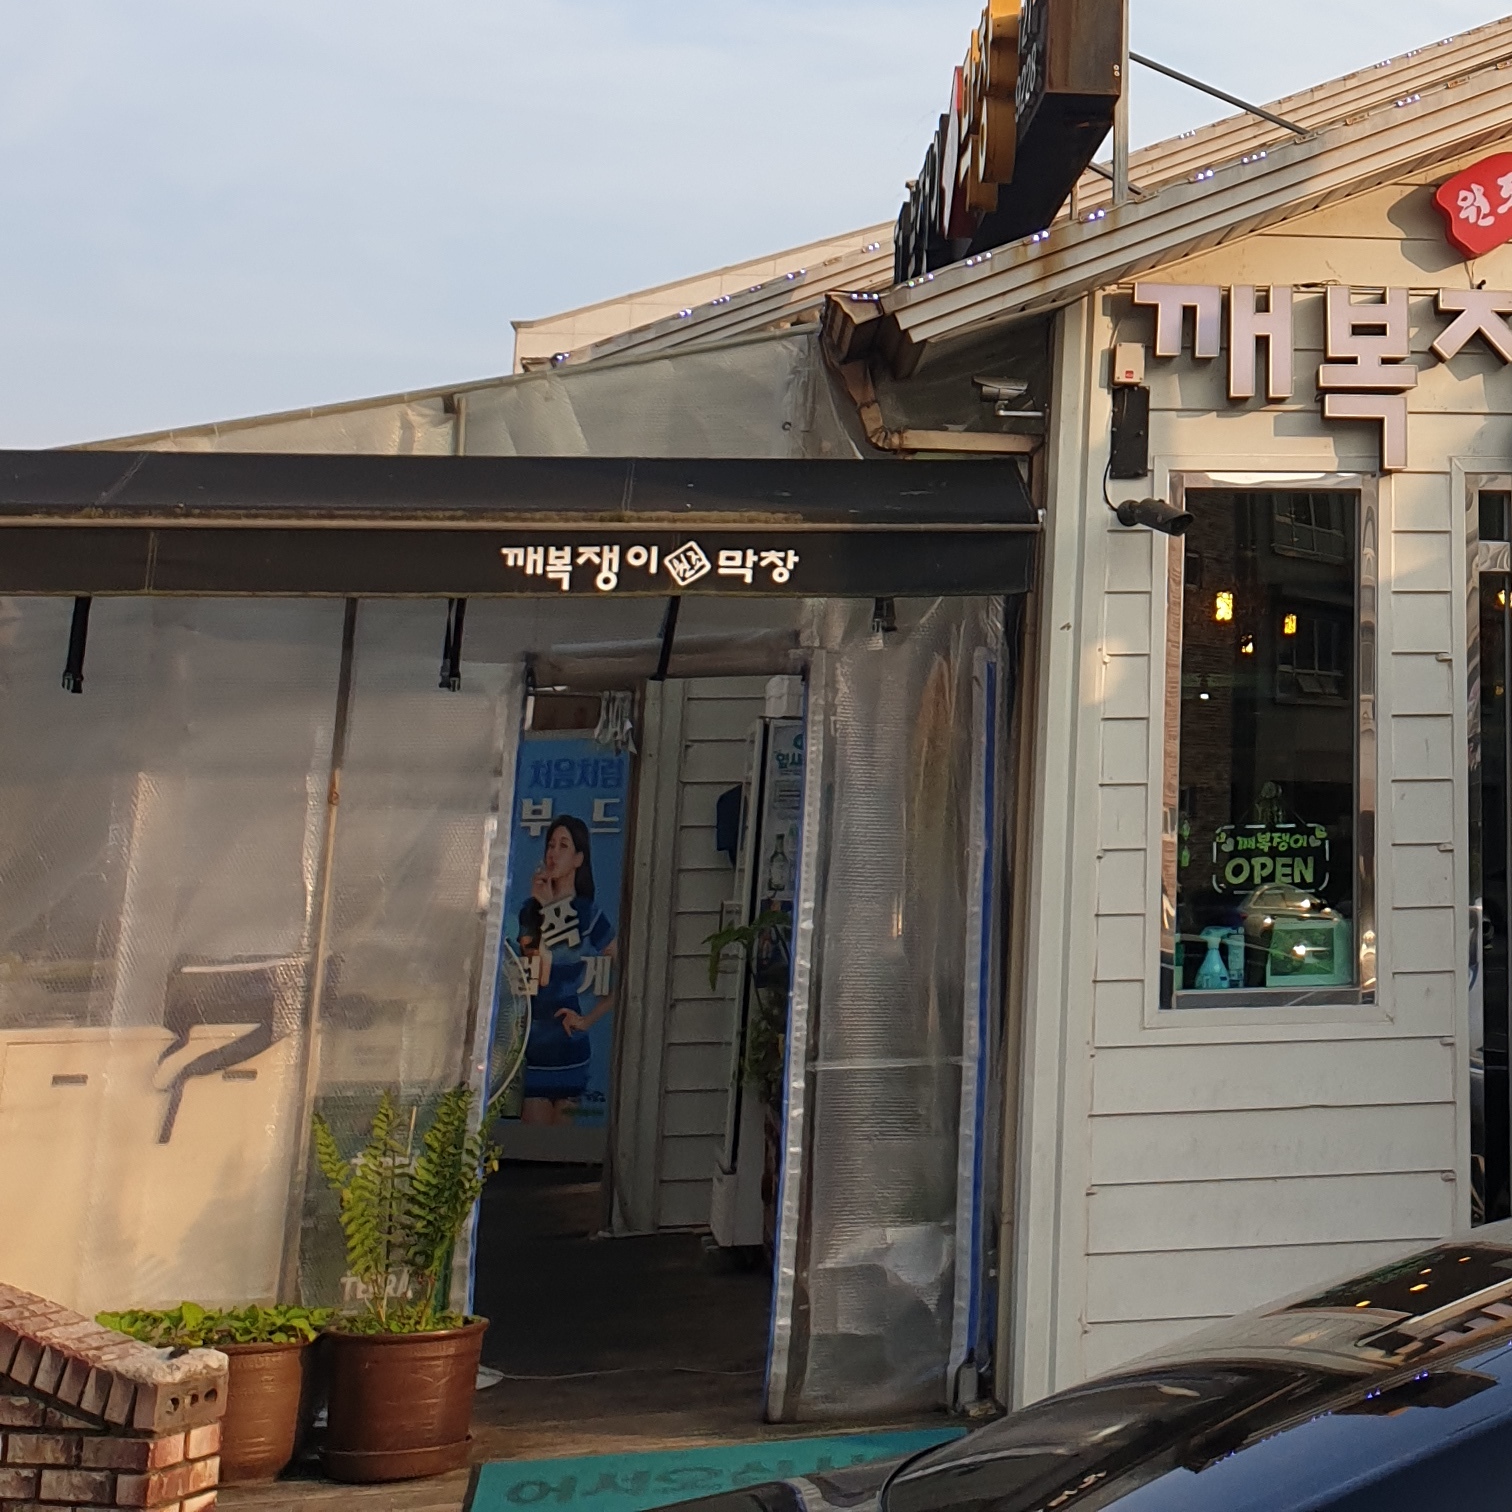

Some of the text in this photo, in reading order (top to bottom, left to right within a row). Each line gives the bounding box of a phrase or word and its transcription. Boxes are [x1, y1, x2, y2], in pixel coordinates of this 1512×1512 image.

[500, 544, 659, 592] 깨복쟁이
[717, 548, 800, 584] 막창
[529, 758, 625, 790] 처음처럼
[1236, 832, 1308, 853] 깨복쟁이
[1224, 855, 1315, 885] OPEN
